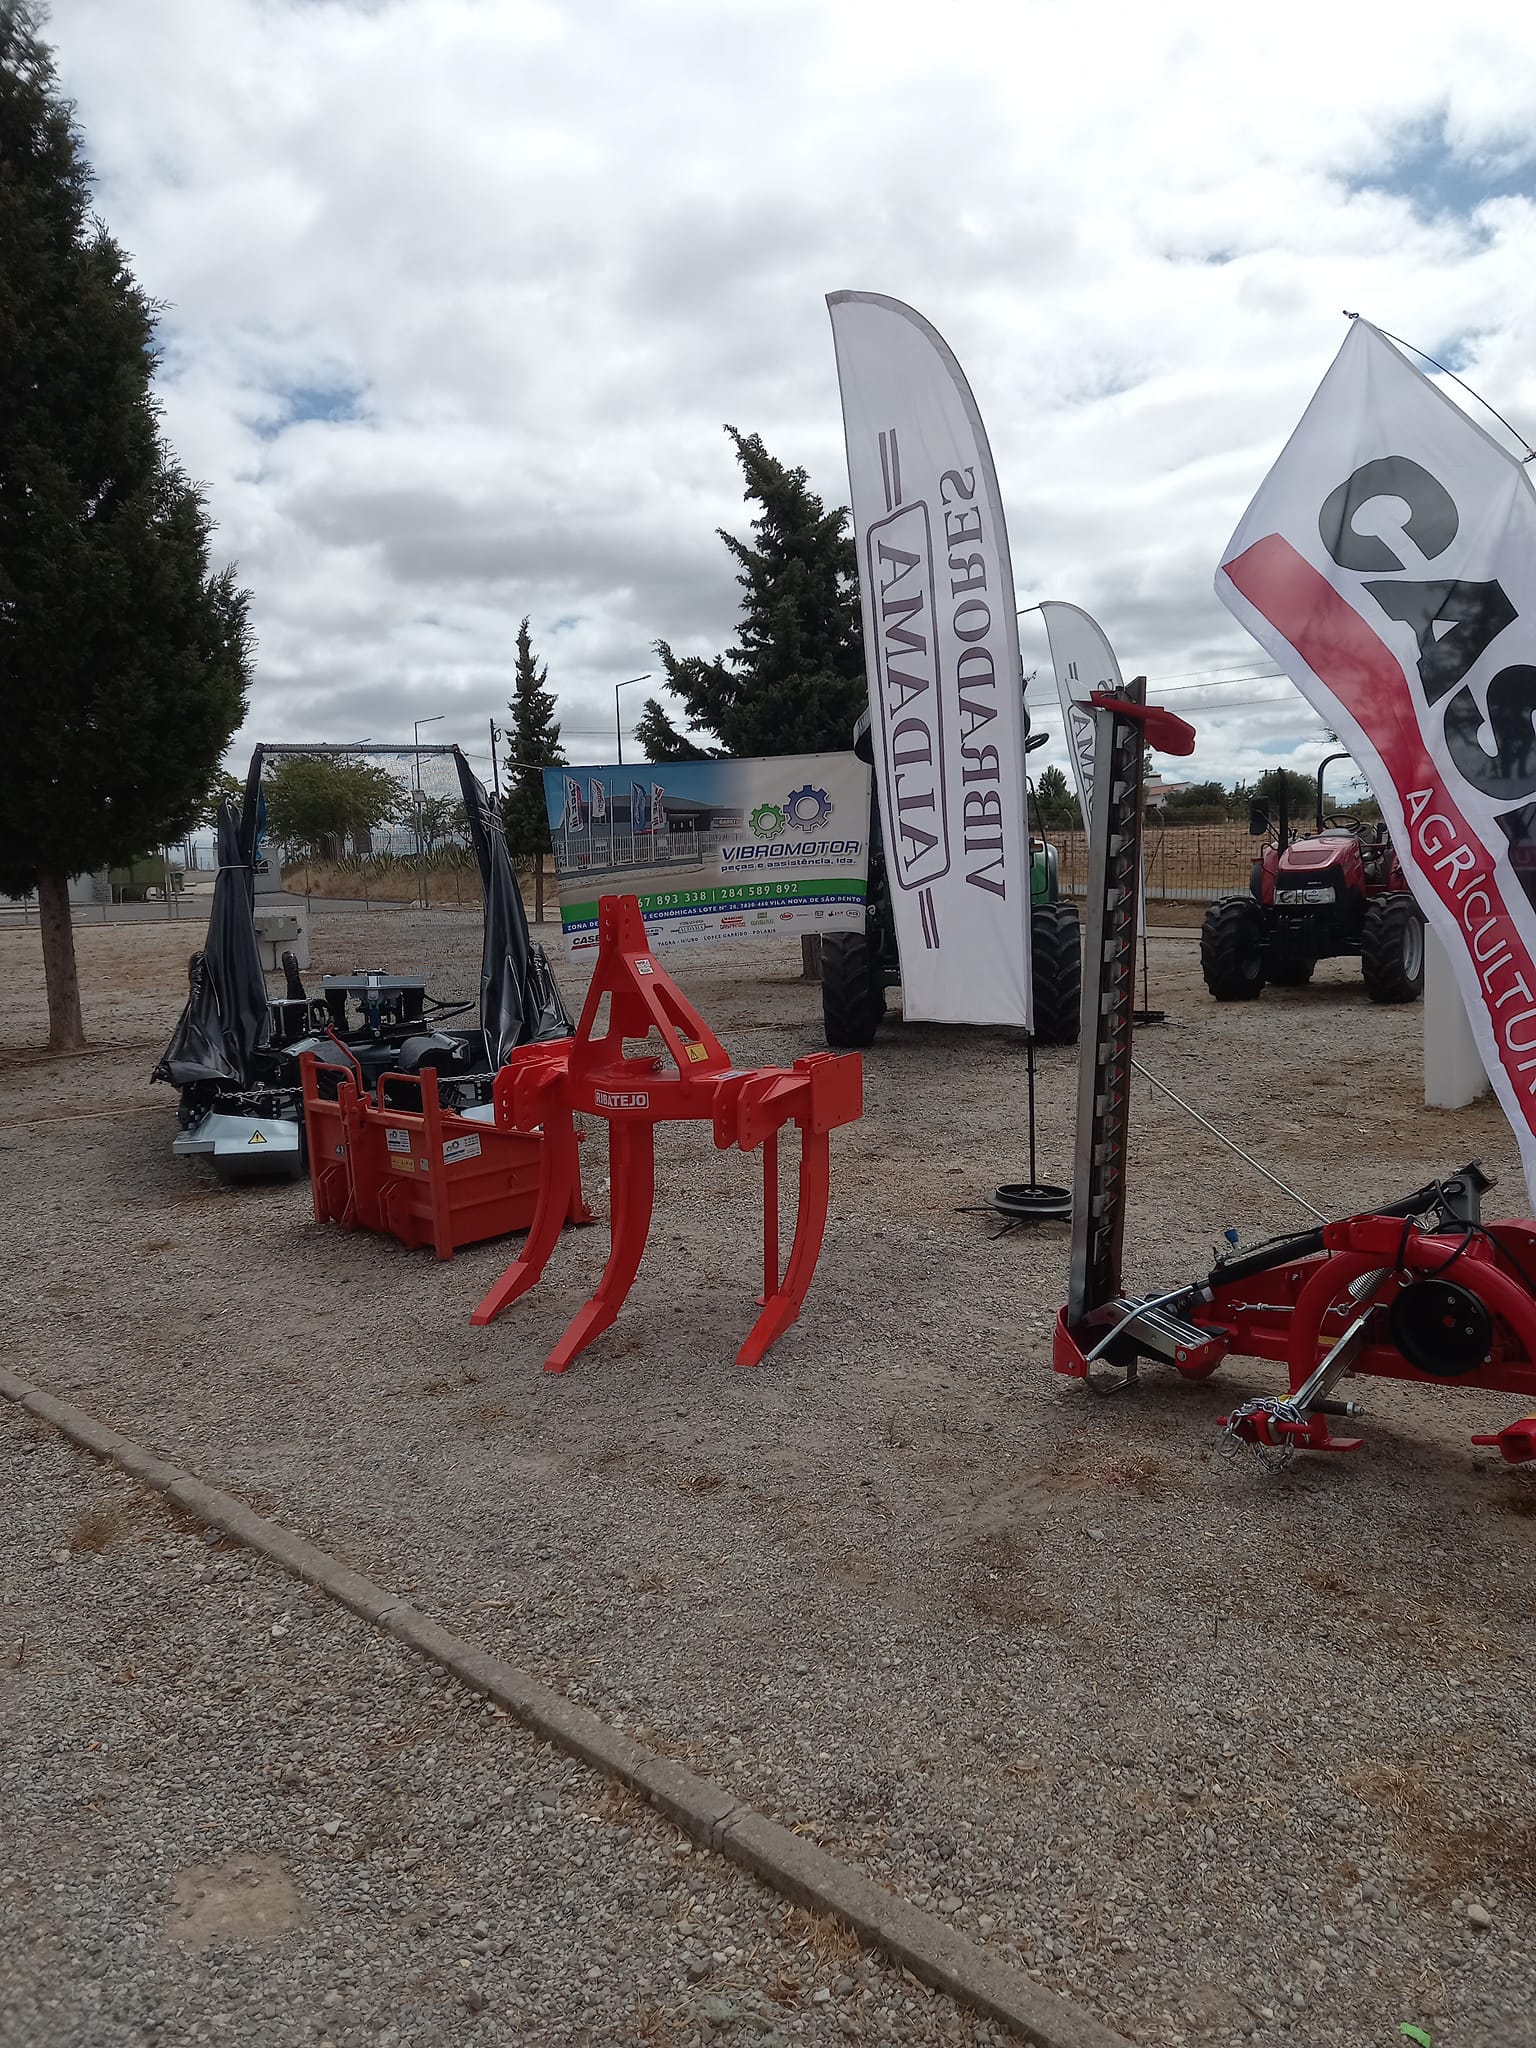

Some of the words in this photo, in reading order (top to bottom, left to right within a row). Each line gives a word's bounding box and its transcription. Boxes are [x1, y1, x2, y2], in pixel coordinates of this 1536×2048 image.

[721, 840, 860, 861] VIBROMOTOR
[721, 863, 754, 873] peças
[767, 857, 834, 868] assistência,
[657, 895, 679, 906] 893
[684, 891, 707, 902] 338
[721, 887, 743, 899] 284
[748, 885, 771, 896] 589
[776, 883, 798, 893] 892
[649, 908, 697, 920] ECONÓMICAS
[698, 906, 717, 914] LOTE
[821, 895, 836, 903] SÃO
[567, 922, 587, 931] ZONA
[572, 934, 600, 946] CASE
[595, 1091, 647, 1107] RIBATEJO
